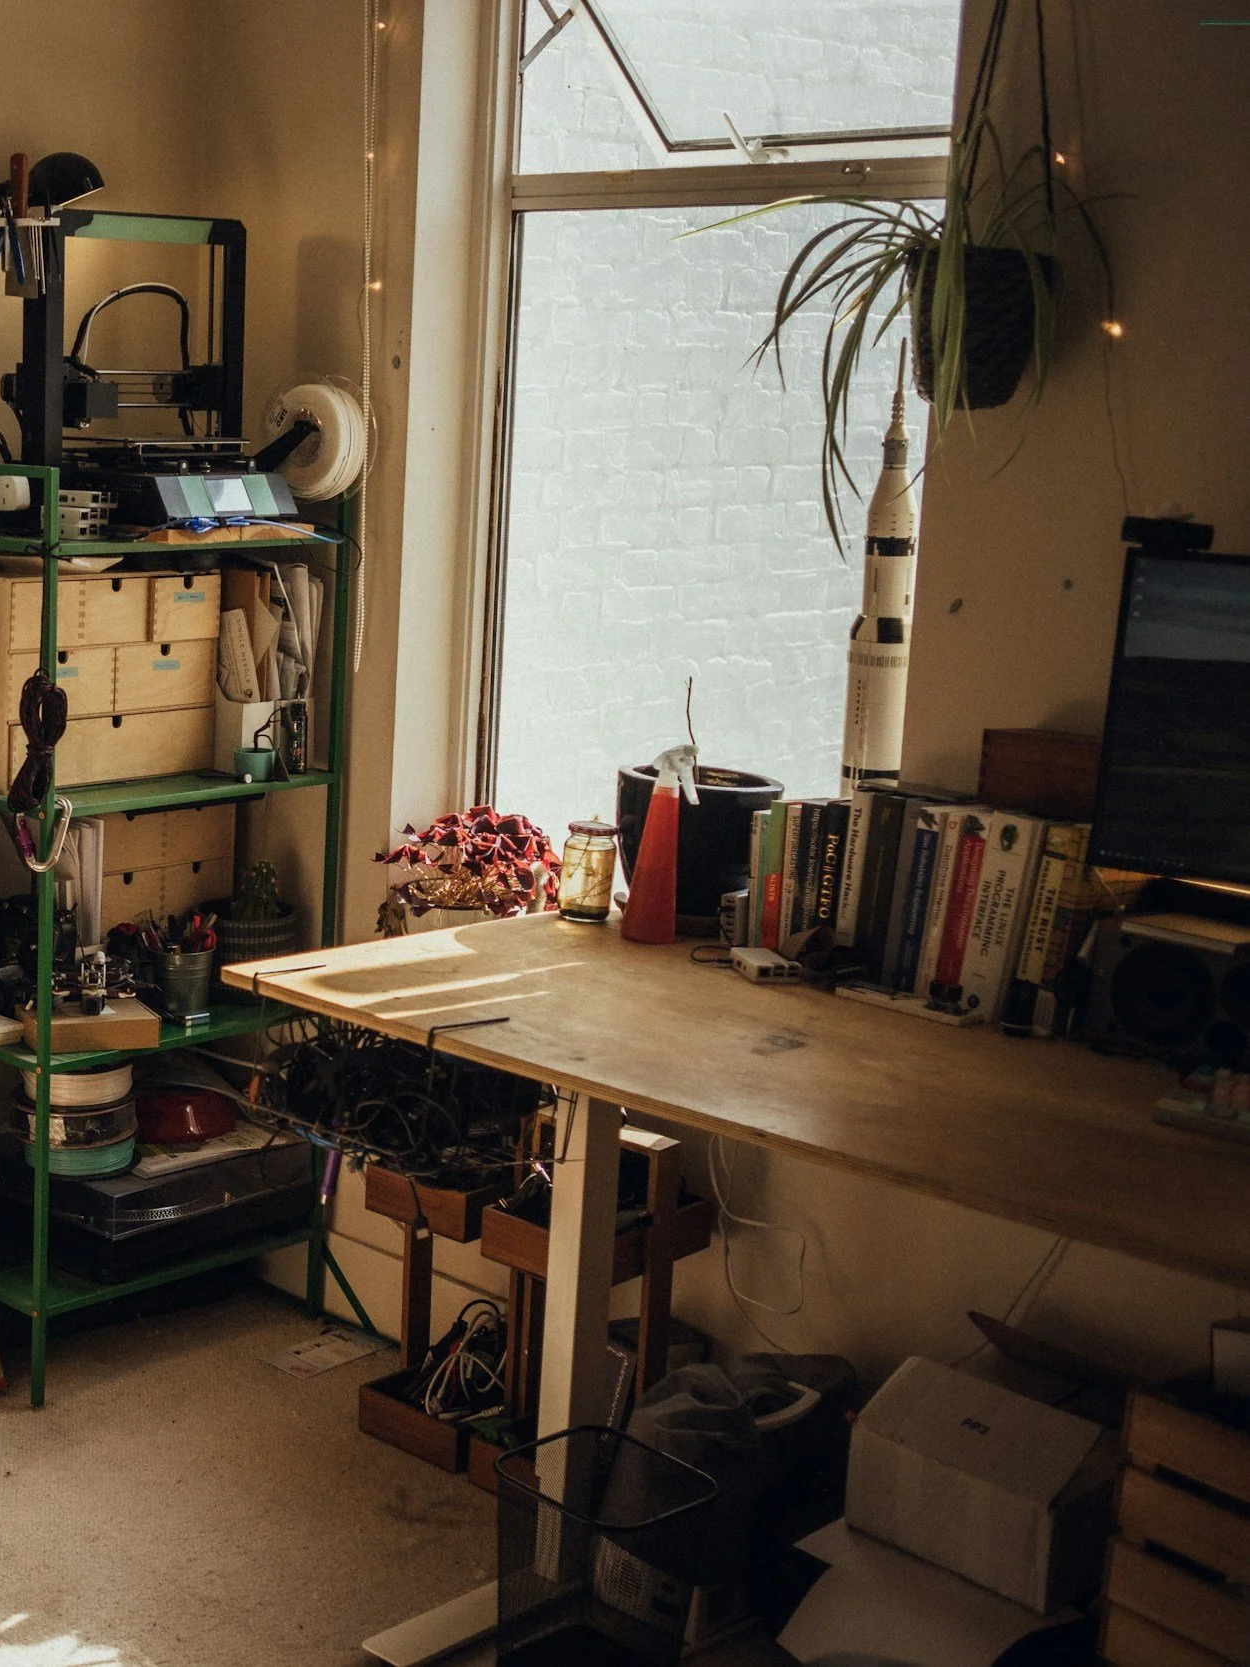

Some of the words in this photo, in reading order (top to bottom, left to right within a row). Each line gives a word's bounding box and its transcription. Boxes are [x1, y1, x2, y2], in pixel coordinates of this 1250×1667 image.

[236, 617, 245, 649] SINGLE
[240, 650, 251, 684] NEEDLE
[852, 807, 862, 828] The
[846, 829, 859, 881] Hardware
[972, 881, 992, 942] INTERFACE
[1003, 887, 1015, 910] THE
[1032, 860, 1051, 928] PROGRAMMING
[1042, 888, 1057, 915] THE
[980, 870, 1005, 957] PROGRAMMING
[995, 912, 1011, 948] LINUX
[1034, 918, 1050, 954] RUST
